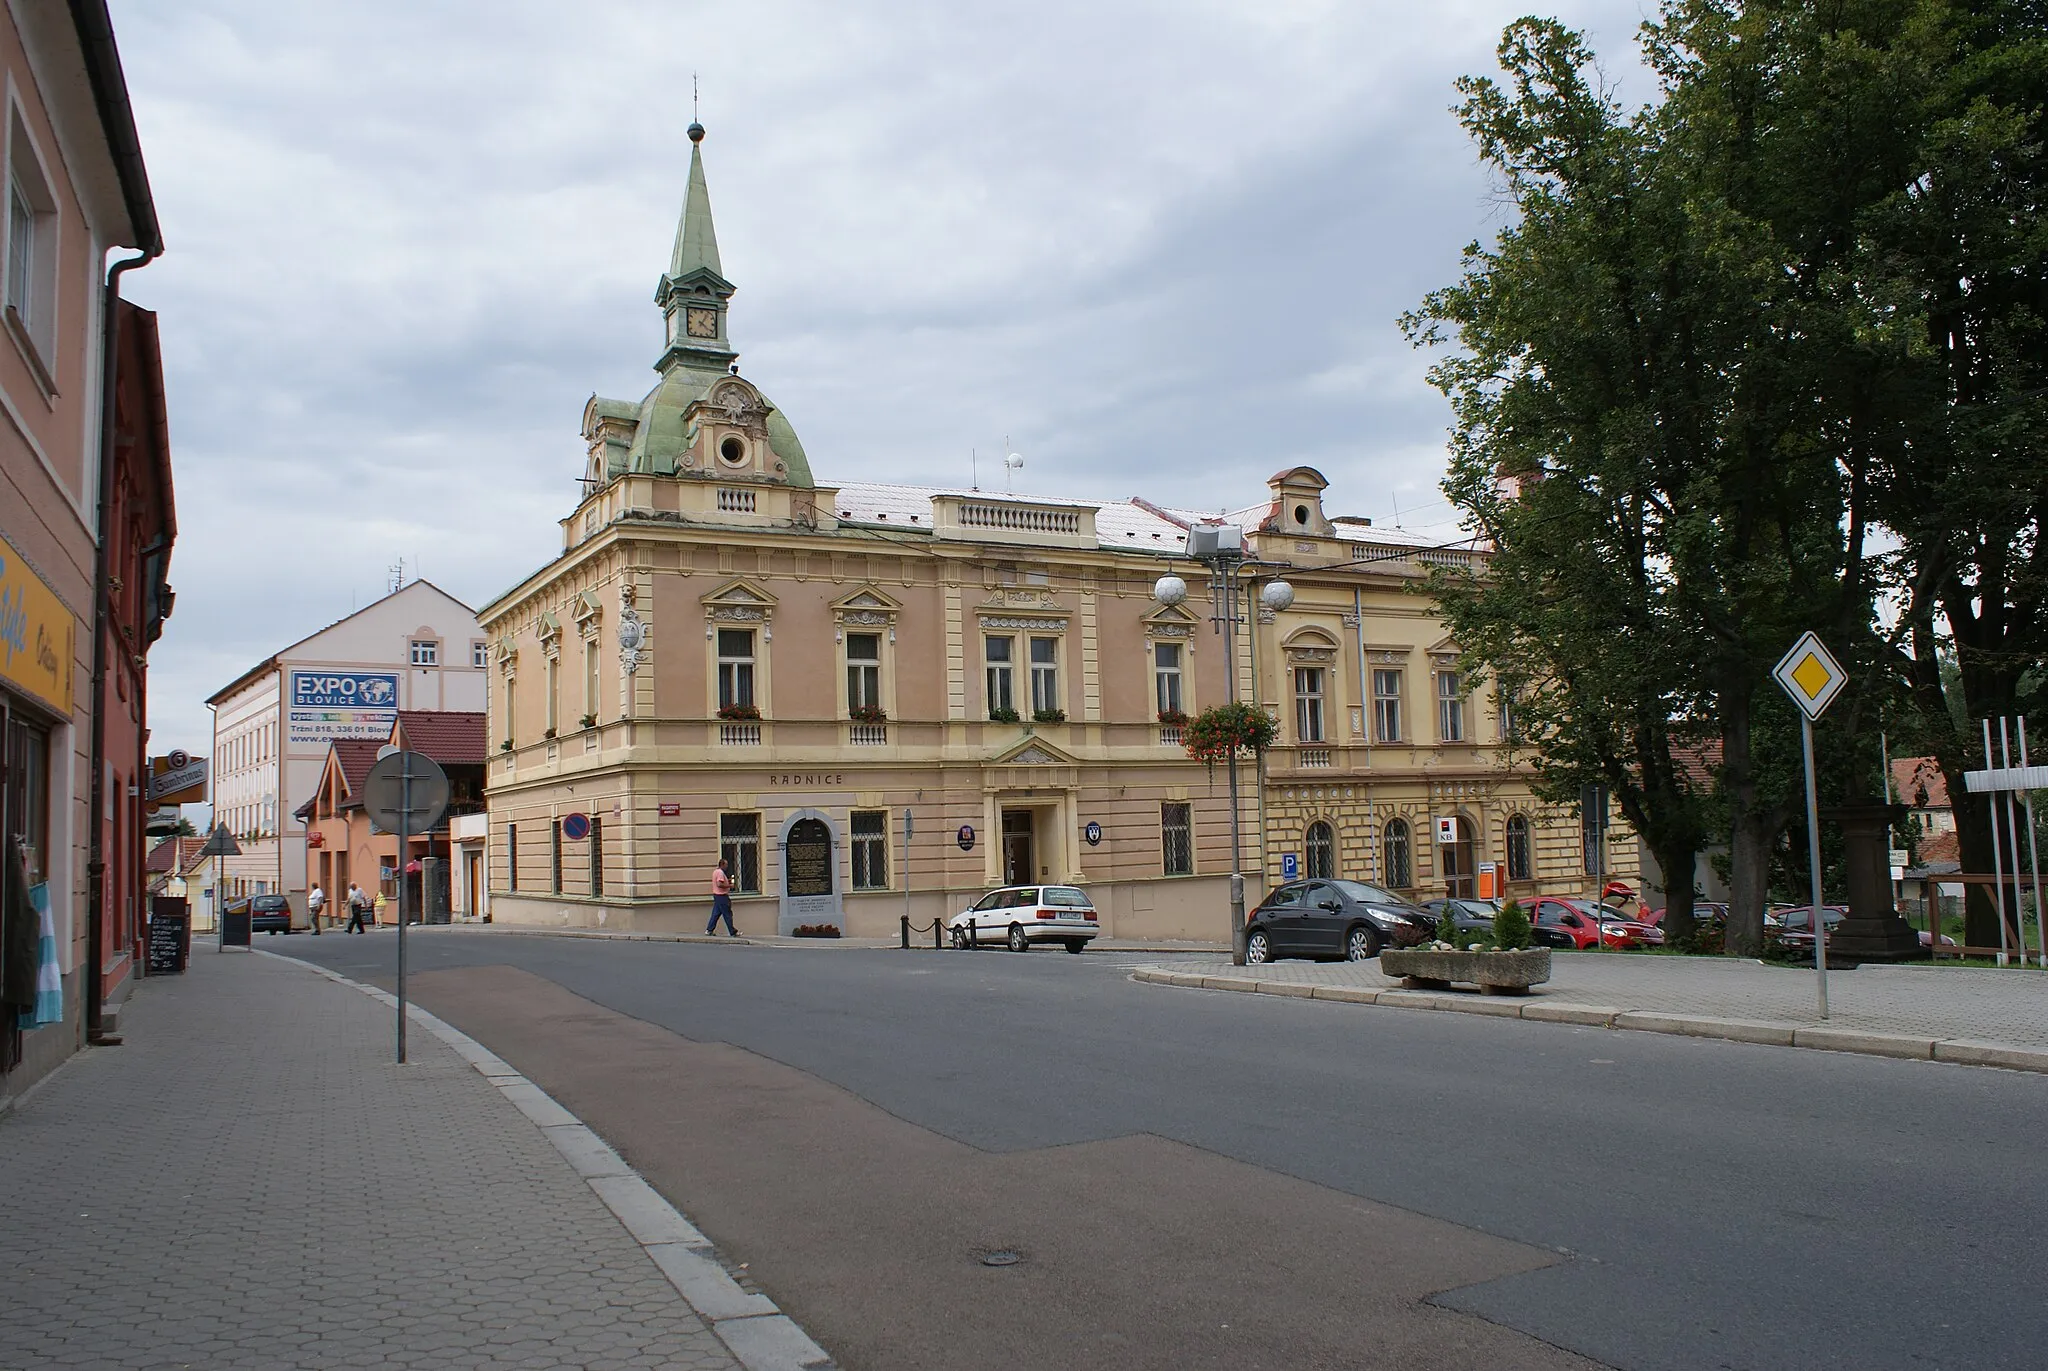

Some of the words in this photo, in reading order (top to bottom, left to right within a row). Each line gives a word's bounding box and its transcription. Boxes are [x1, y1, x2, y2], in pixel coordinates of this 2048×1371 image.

[297, 677, 357, 695] EXPO
[297, 695, 355, 704] BLOVICE
[315, 725, 334, 733] 818,
[155, 768, 204, 792] Gambrinus
[769, 774, 842, 785] RADNICE
[1440, 833, 1452, 841] KB
[1286, 856, 1294, 872] P
